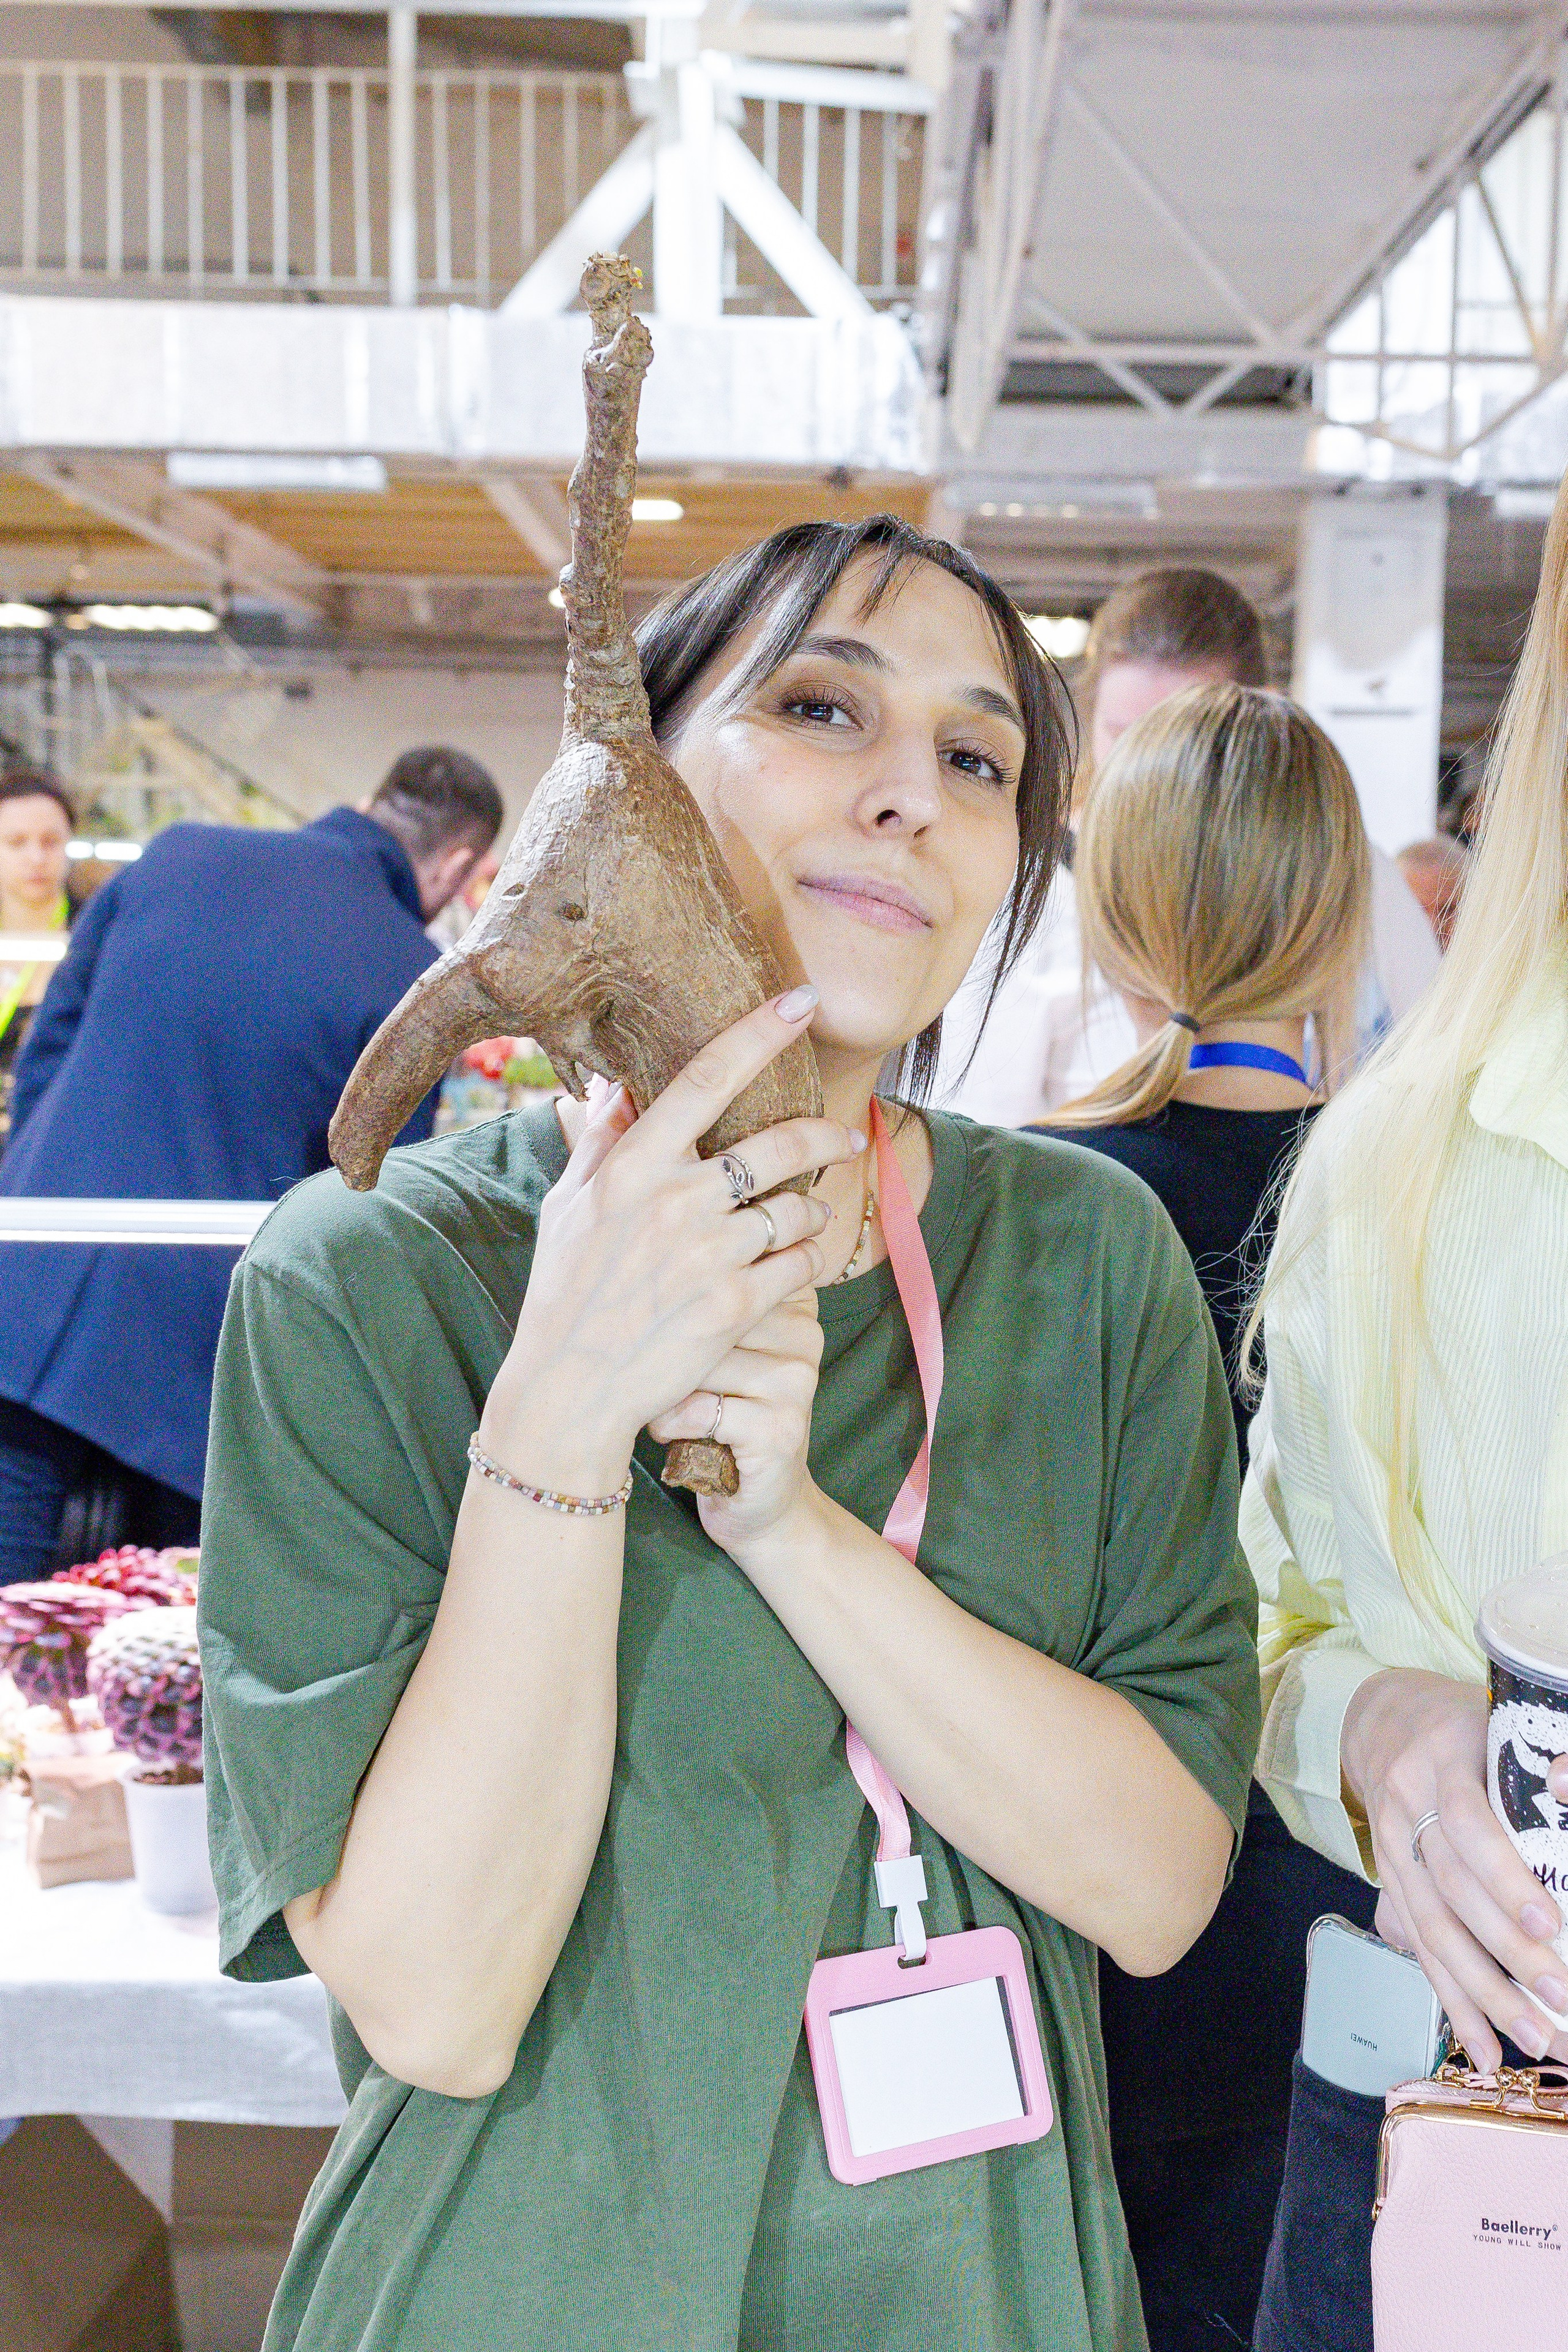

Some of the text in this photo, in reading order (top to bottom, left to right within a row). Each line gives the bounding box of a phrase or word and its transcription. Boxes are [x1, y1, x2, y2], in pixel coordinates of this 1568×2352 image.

[1350, 2032, 1378, 2052] HUAWEI
[1473, 2234, 1562, 2251] YOUNG WILL SHOW
